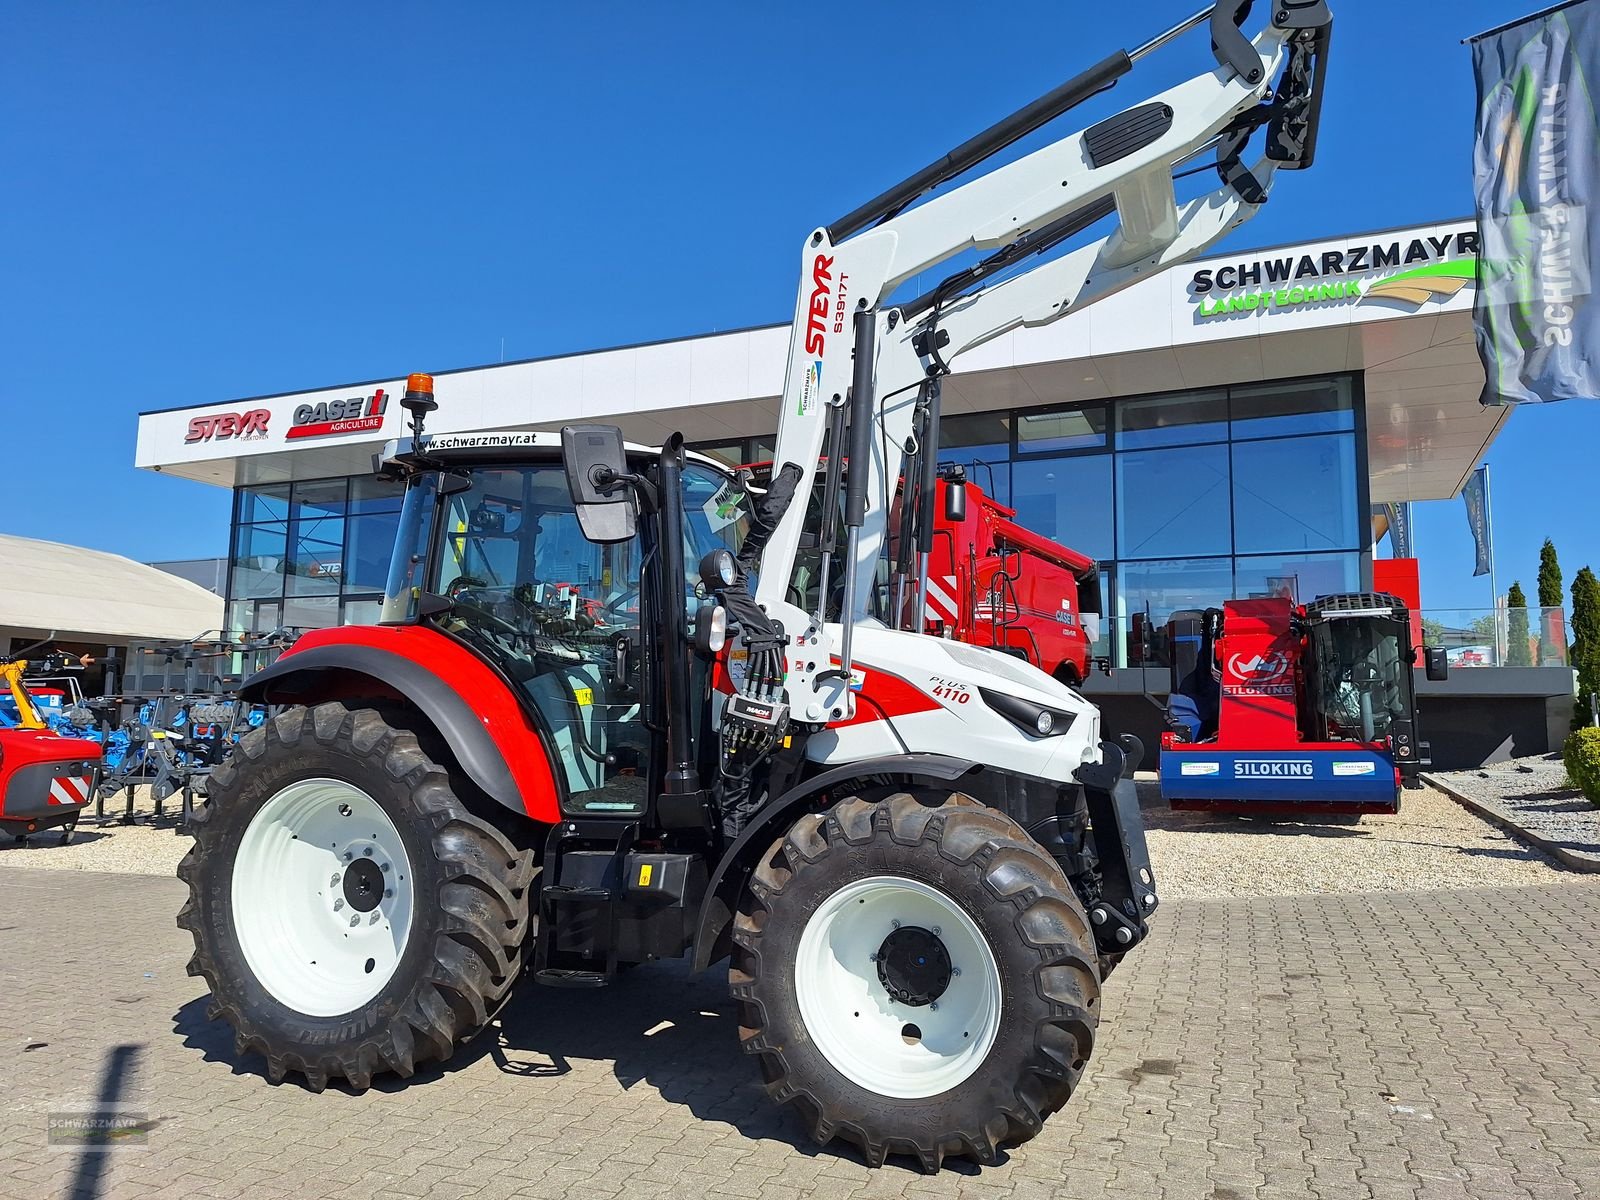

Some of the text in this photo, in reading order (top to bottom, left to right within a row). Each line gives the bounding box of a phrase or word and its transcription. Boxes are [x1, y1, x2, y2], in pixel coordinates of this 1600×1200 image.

[1193, 231, 1479, 294] SCHWARZMAYR
[805, 254, 834, 358] STEYR
[833, 272, 849, 334] S3917T
[1199, 280, 1362, 317] LANDTECHNIK
[184, 408, 271, 443] STEYR
[293, 398, 364, 426] CASE
[329, 418, 379, 432] AGRICULTURE
[929, 676, 967, 690] PLUS
[932, 685, 970, 704] 4110
[1223, 687, 1294, 695] SILOKING
[1234, 763, 1313, 775] SILOKING
